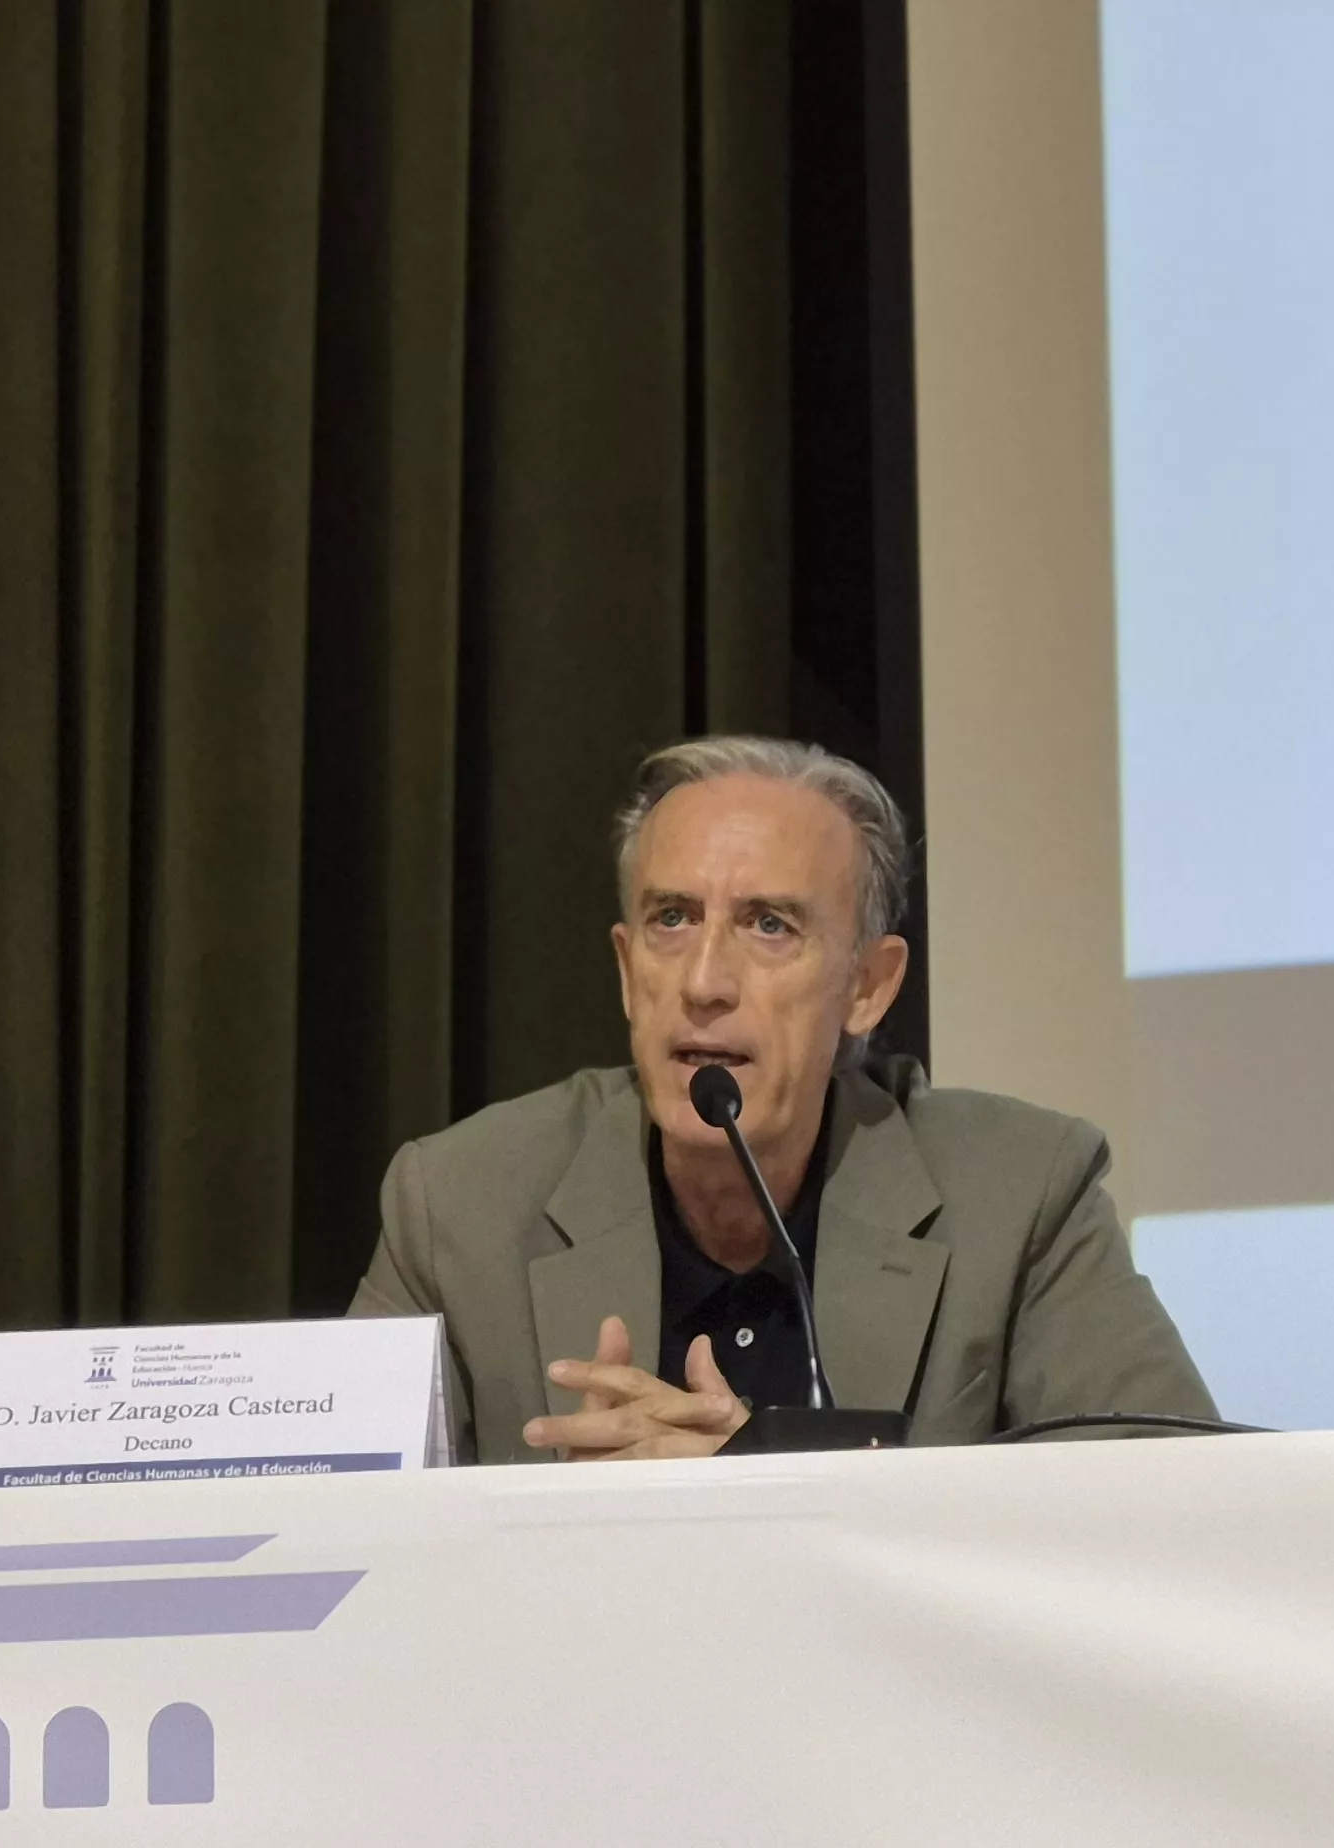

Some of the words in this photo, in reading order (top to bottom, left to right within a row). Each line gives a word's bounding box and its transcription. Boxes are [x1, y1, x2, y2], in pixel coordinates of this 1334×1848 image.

[131, 1375, 198, 1388] Universidad
[198, 1374, 253, 1387] Zaragoza
[28, 1402, 101, 1425] Javier
[107, 1400, 219, 1424] Zaragoza
[228, 1392, 335, 1416] Casterad
[123, 1435, 193, 1452] Decano
[3, 1471, 61, 1486] Facultad
[64, 1470, 83, 1484] de
[86, 1468, 142, 1482] Ciencias
[145, 1467, 210, 1481] Humanas
[213, 1467, 222, 1479] y
[224, 1464, 242, 1477] de
[245, 1463, 258, 1477] la
[261, 1461, 332, 1476] Educación
